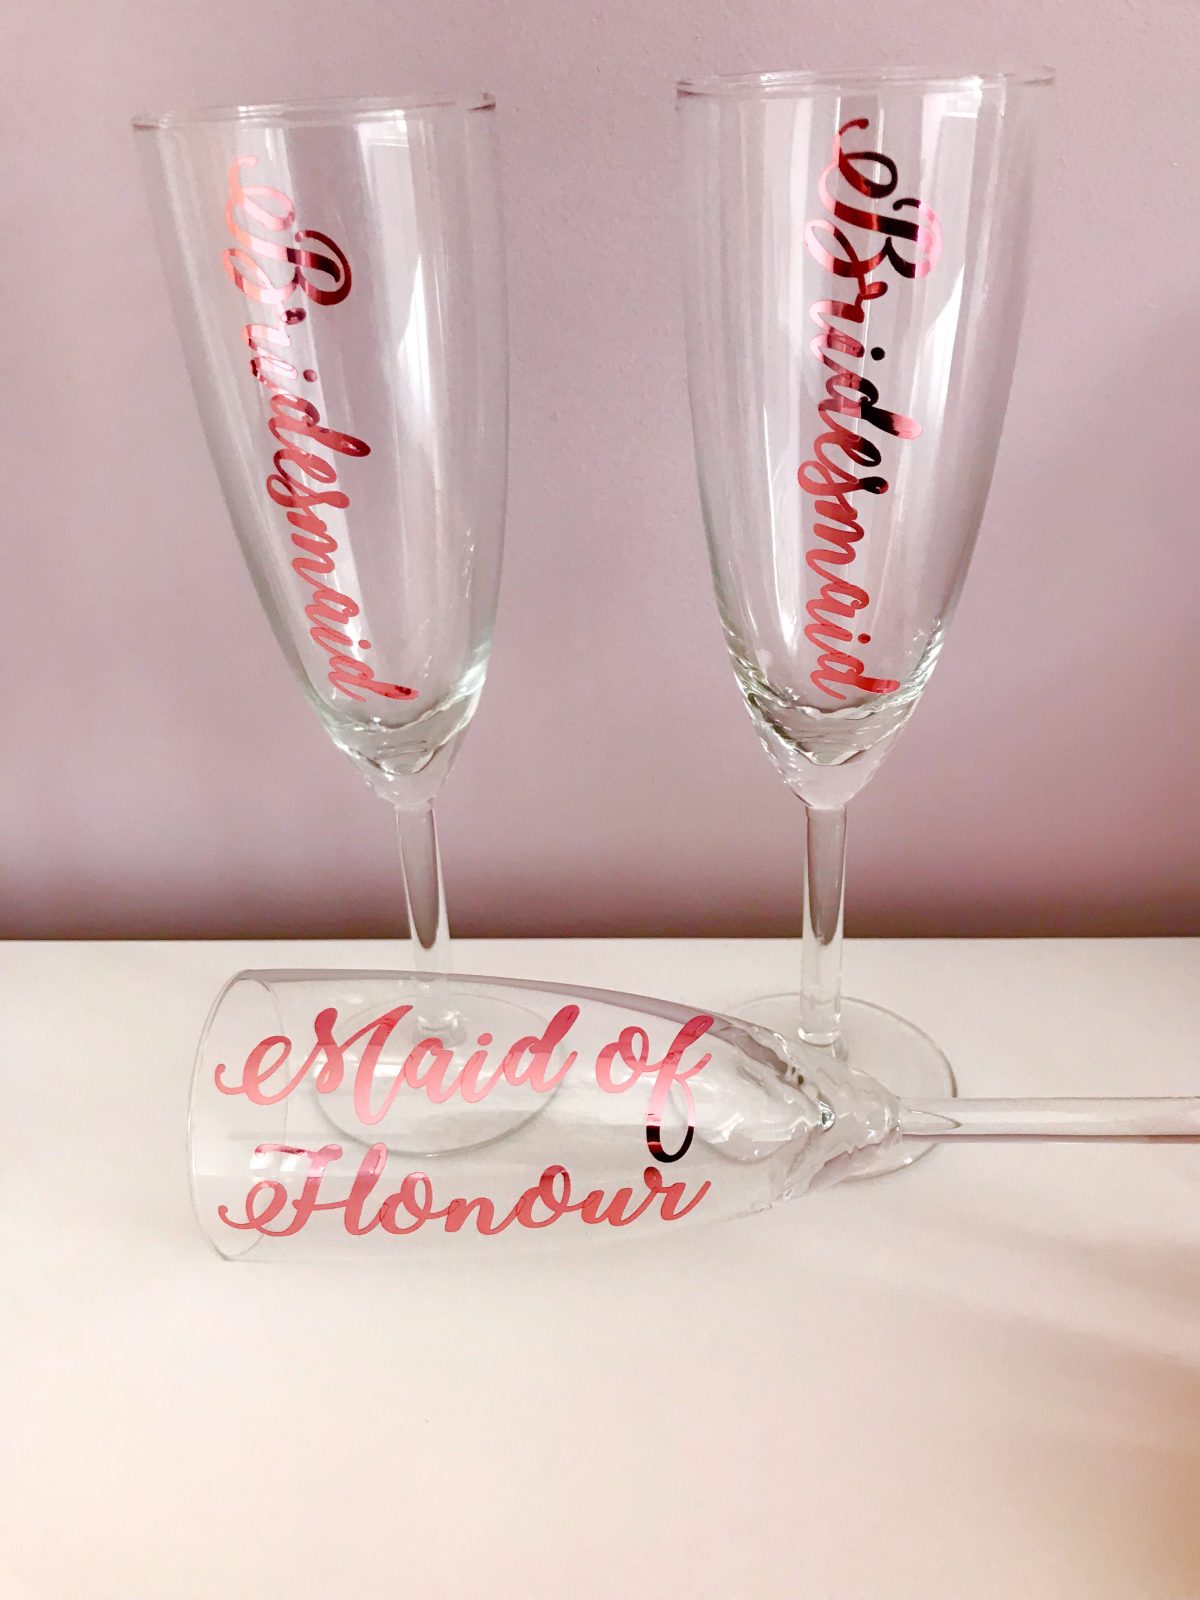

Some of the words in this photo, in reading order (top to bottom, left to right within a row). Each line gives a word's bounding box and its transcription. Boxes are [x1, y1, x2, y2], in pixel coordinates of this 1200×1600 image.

[222, 156, 420, 703] Bridesmaid
[797, 117, 944, 700] Bridesmaid
[214, 1004, 580, 1126] Maid
[595, 1015, 714, 1164] of
[217, 1142, 712, 1237] Honour
